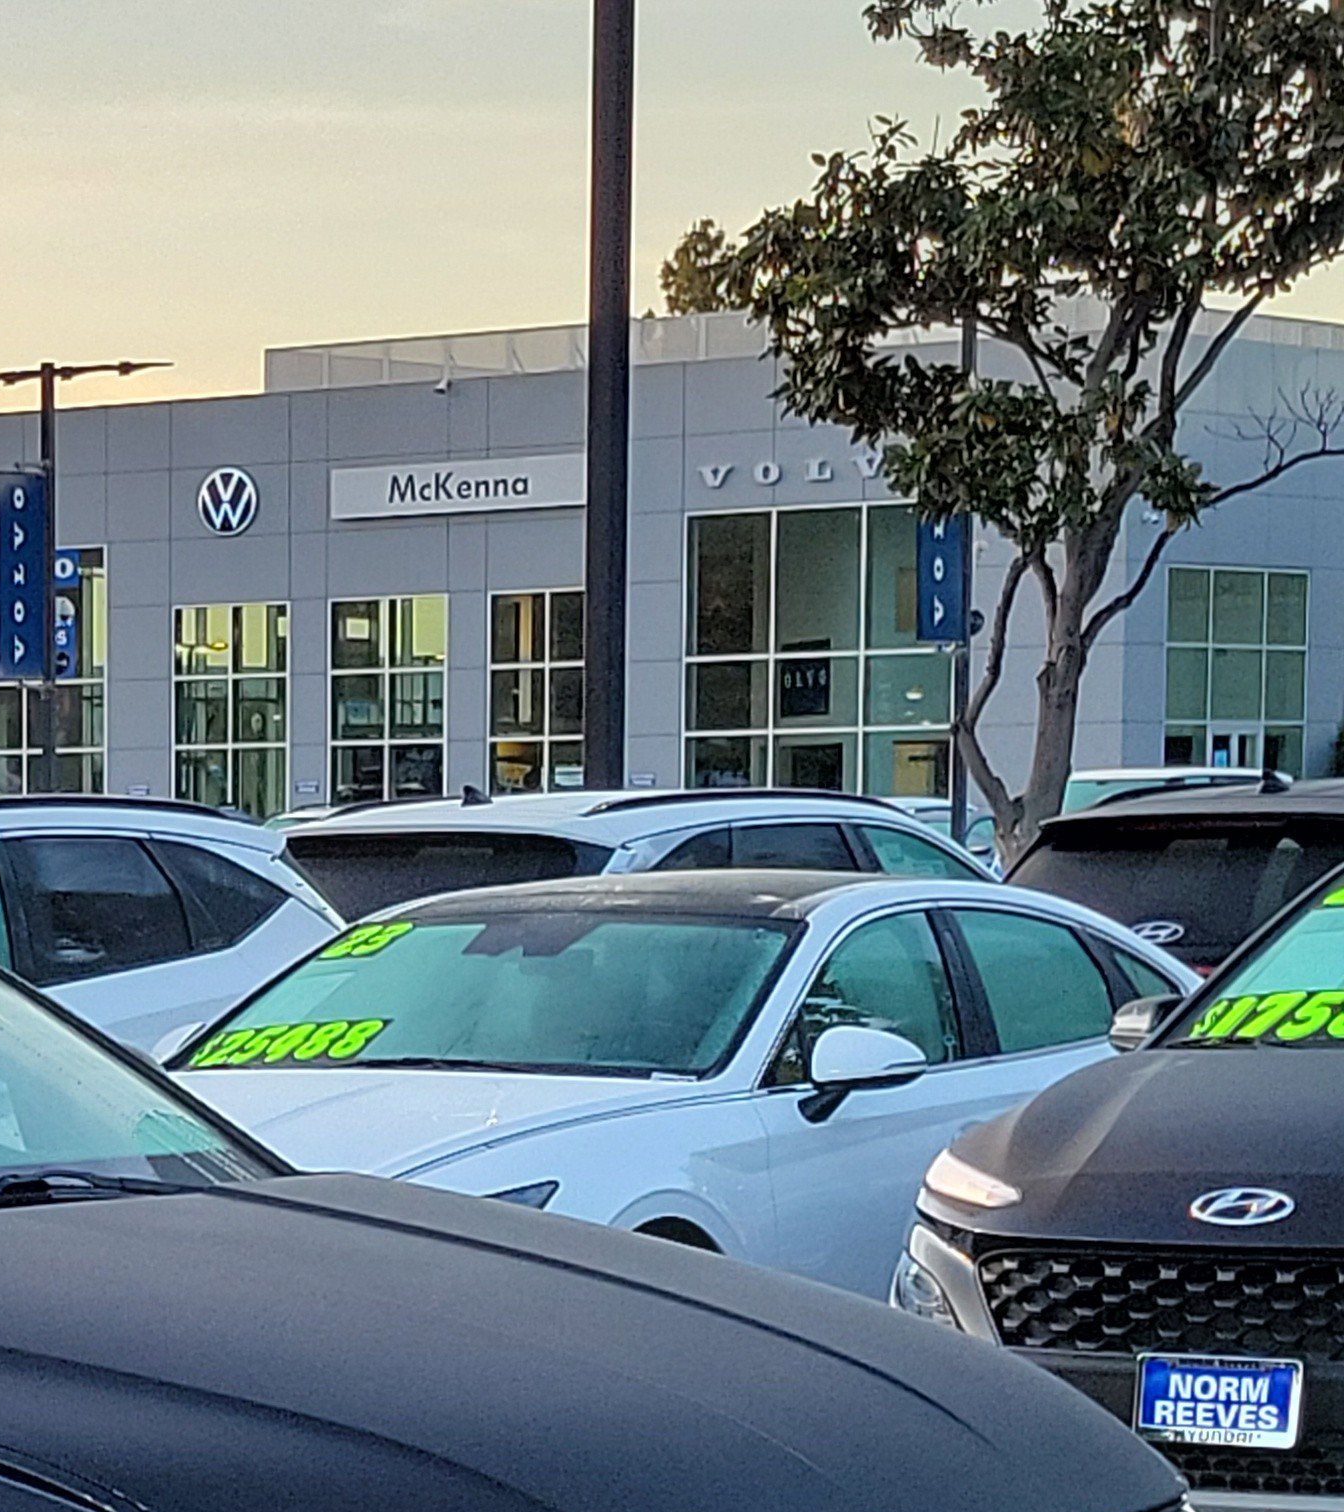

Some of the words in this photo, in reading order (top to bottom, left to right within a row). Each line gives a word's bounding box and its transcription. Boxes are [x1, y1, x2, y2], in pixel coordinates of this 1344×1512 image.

[699, 452, 885, 488] VOLV
[388, 472, 529, 504] McKenna
[13, 487, 25, 665] VOLVO
[933, 514, 945, 628] VOL
[1168, 1373, 1270, 1403] NORM
[1154, 1400, 1279, 1430] REEVES
